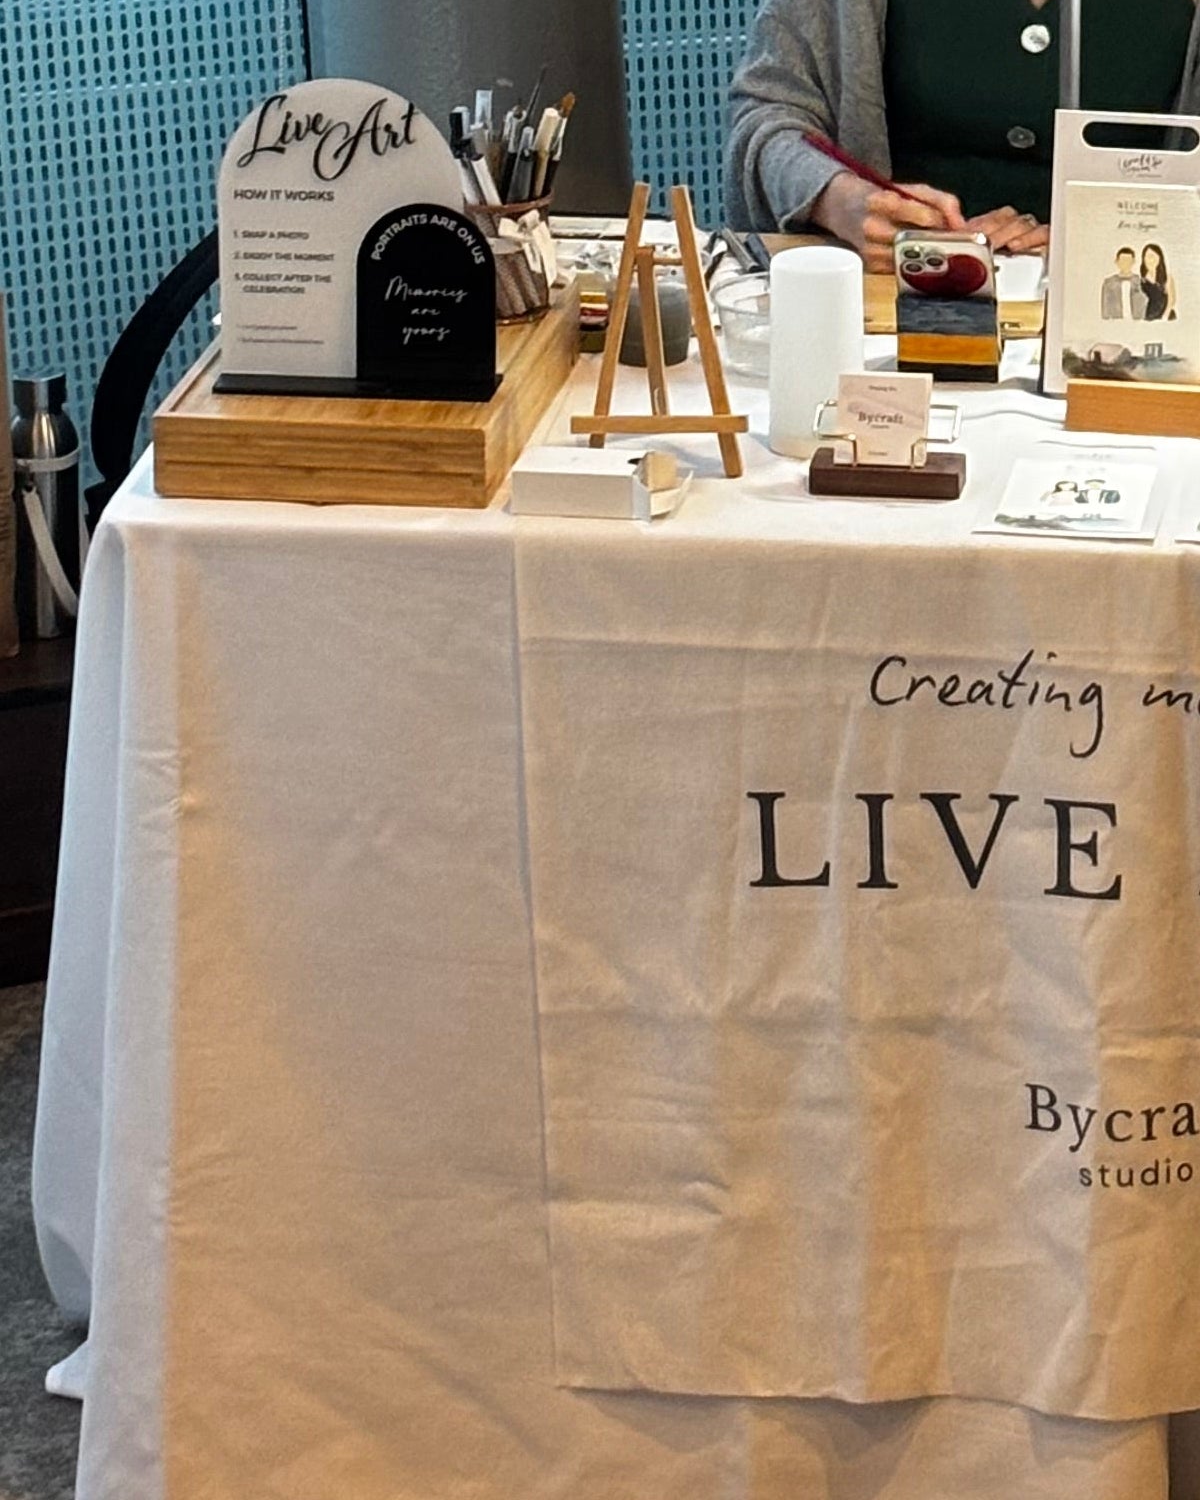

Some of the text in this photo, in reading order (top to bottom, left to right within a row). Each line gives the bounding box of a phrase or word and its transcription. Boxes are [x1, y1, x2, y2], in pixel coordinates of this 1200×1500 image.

[236, 94, 418, 182] Live Art
[234, 189, 335, 202] HOW IT WORKS
[277, 232, 309, 240] PHOTO
[371, 213, 486, 265] PORTRAITS ARE ON US
[242, 273, 282, 282] COLLECT
[314, 275, 331, 283] THE
[243, 285, 305, 294] CELEBRATION
[384, 275, 468, 303] Memories
[402, 327, 450, 345] yours
[858, 412, 904, 425] Bycraft
[869, 650, 1105, 758] Creating
[746, 791, 1123, 901] LIVE
[1078, 1158, 1195, 1189] studio
